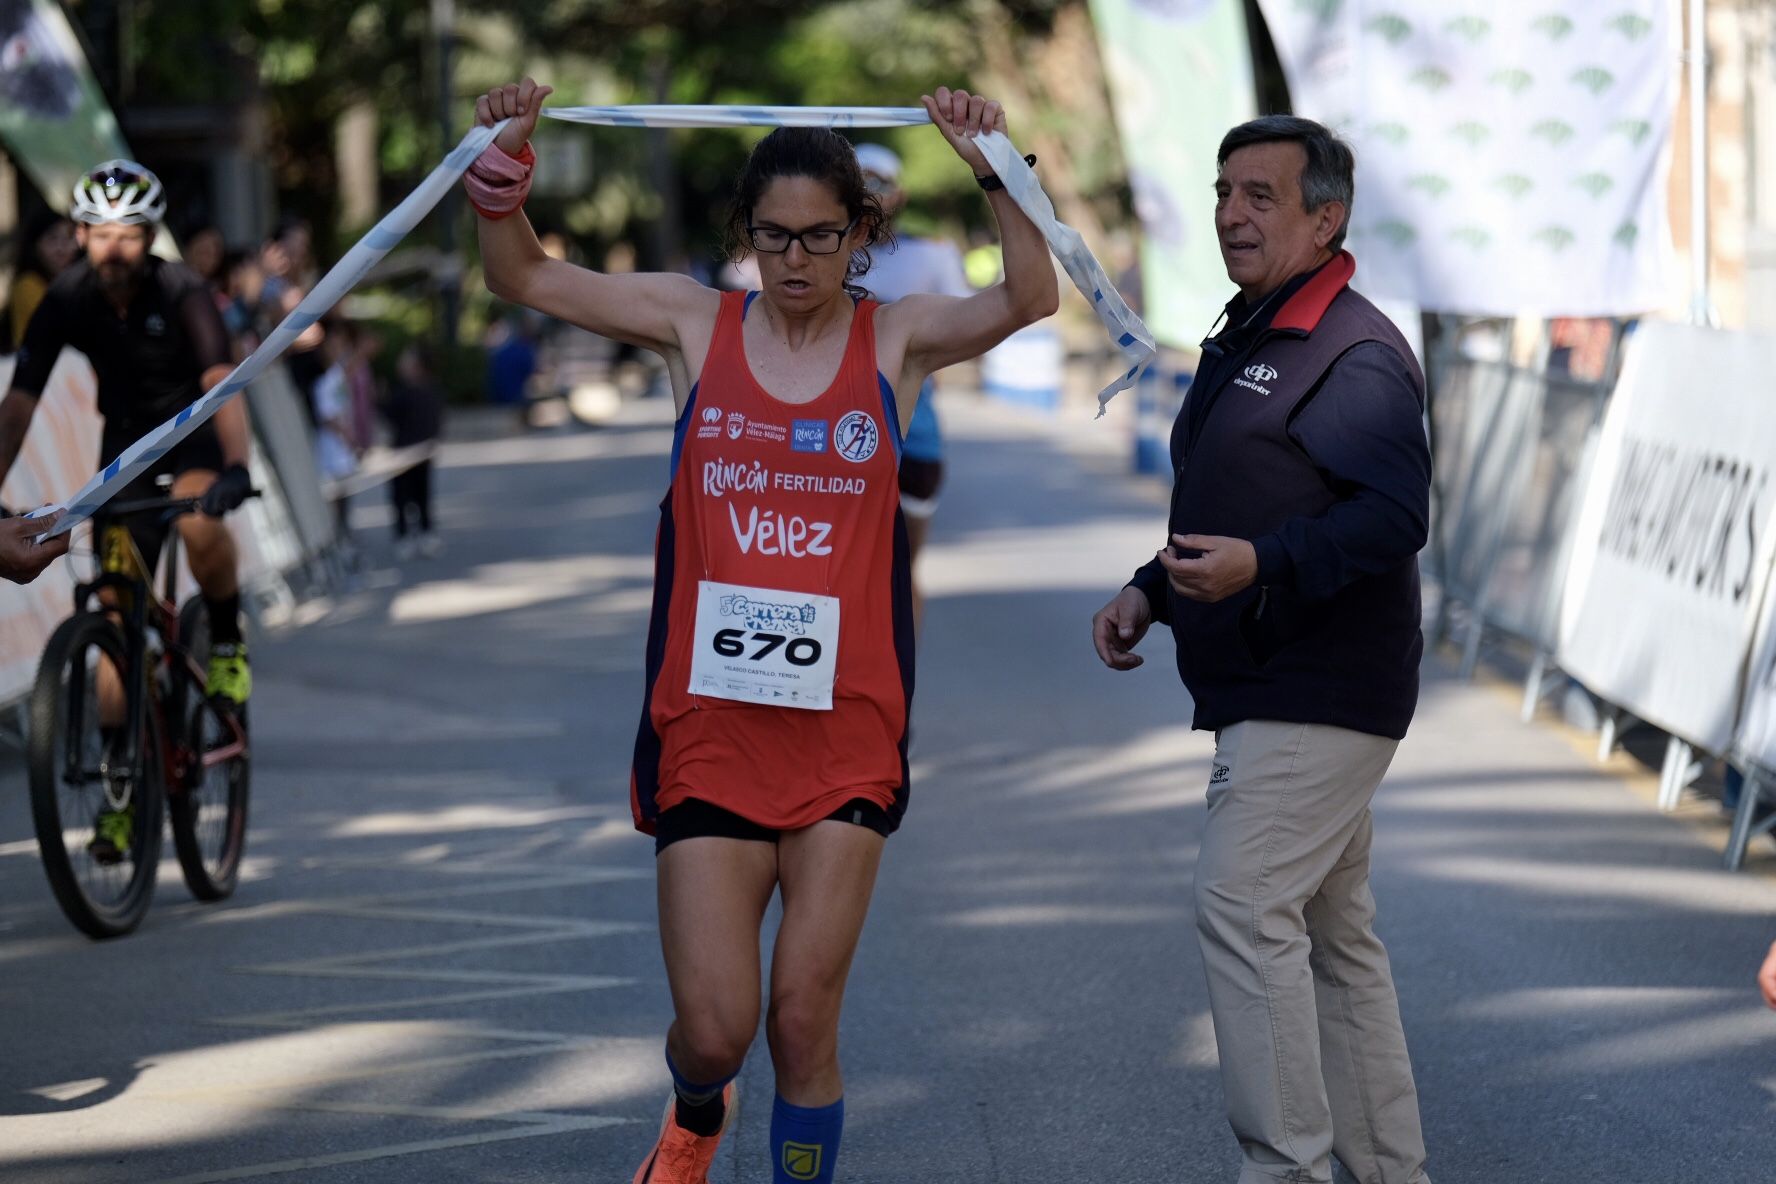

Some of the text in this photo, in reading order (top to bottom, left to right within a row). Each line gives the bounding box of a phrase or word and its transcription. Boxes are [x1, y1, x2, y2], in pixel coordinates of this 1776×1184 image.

[746, 428, 785, 441] Vélez-Málaga
[747, 420, 787, 433] Ayuntamiento
[774, 473, 866, 495] FERTILIDAD
[728, 500, 833, 558] Vélez
[713, 629, 822, 666] 670
[778, 672, 801, 680] TERESA
